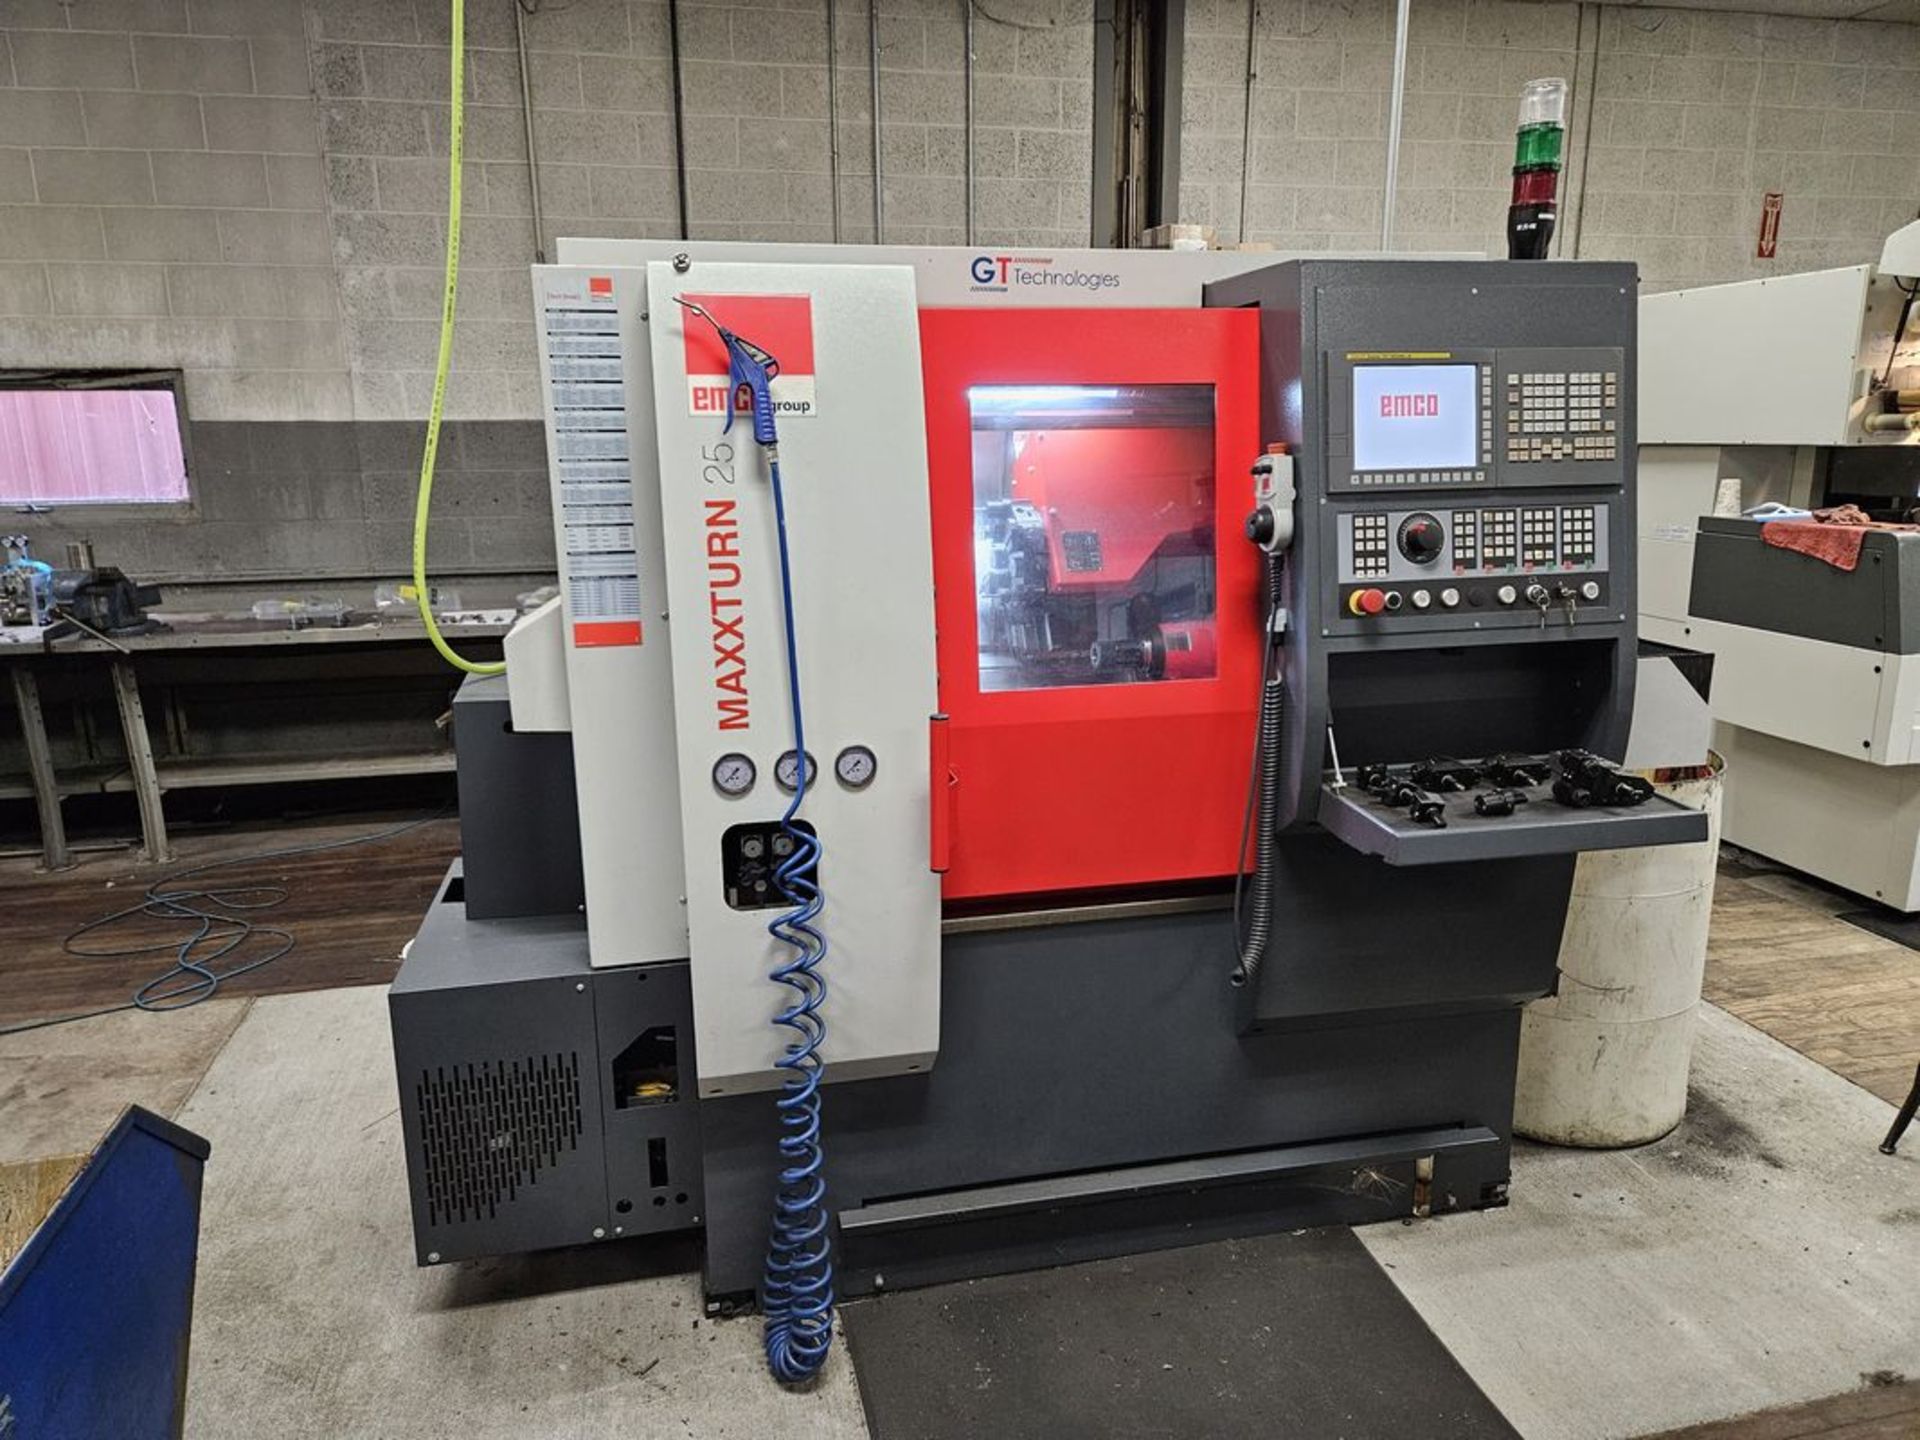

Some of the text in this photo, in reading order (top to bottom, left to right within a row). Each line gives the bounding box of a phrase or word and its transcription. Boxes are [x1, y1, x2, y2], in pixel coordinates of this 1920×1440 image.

[971, 256, 1120, 290] GT Technologies
[692, 386, 751, 411] emc
[1380, 394, 1438, 417] emco
[702, 442, 750, 731] MAXXTURN 25
